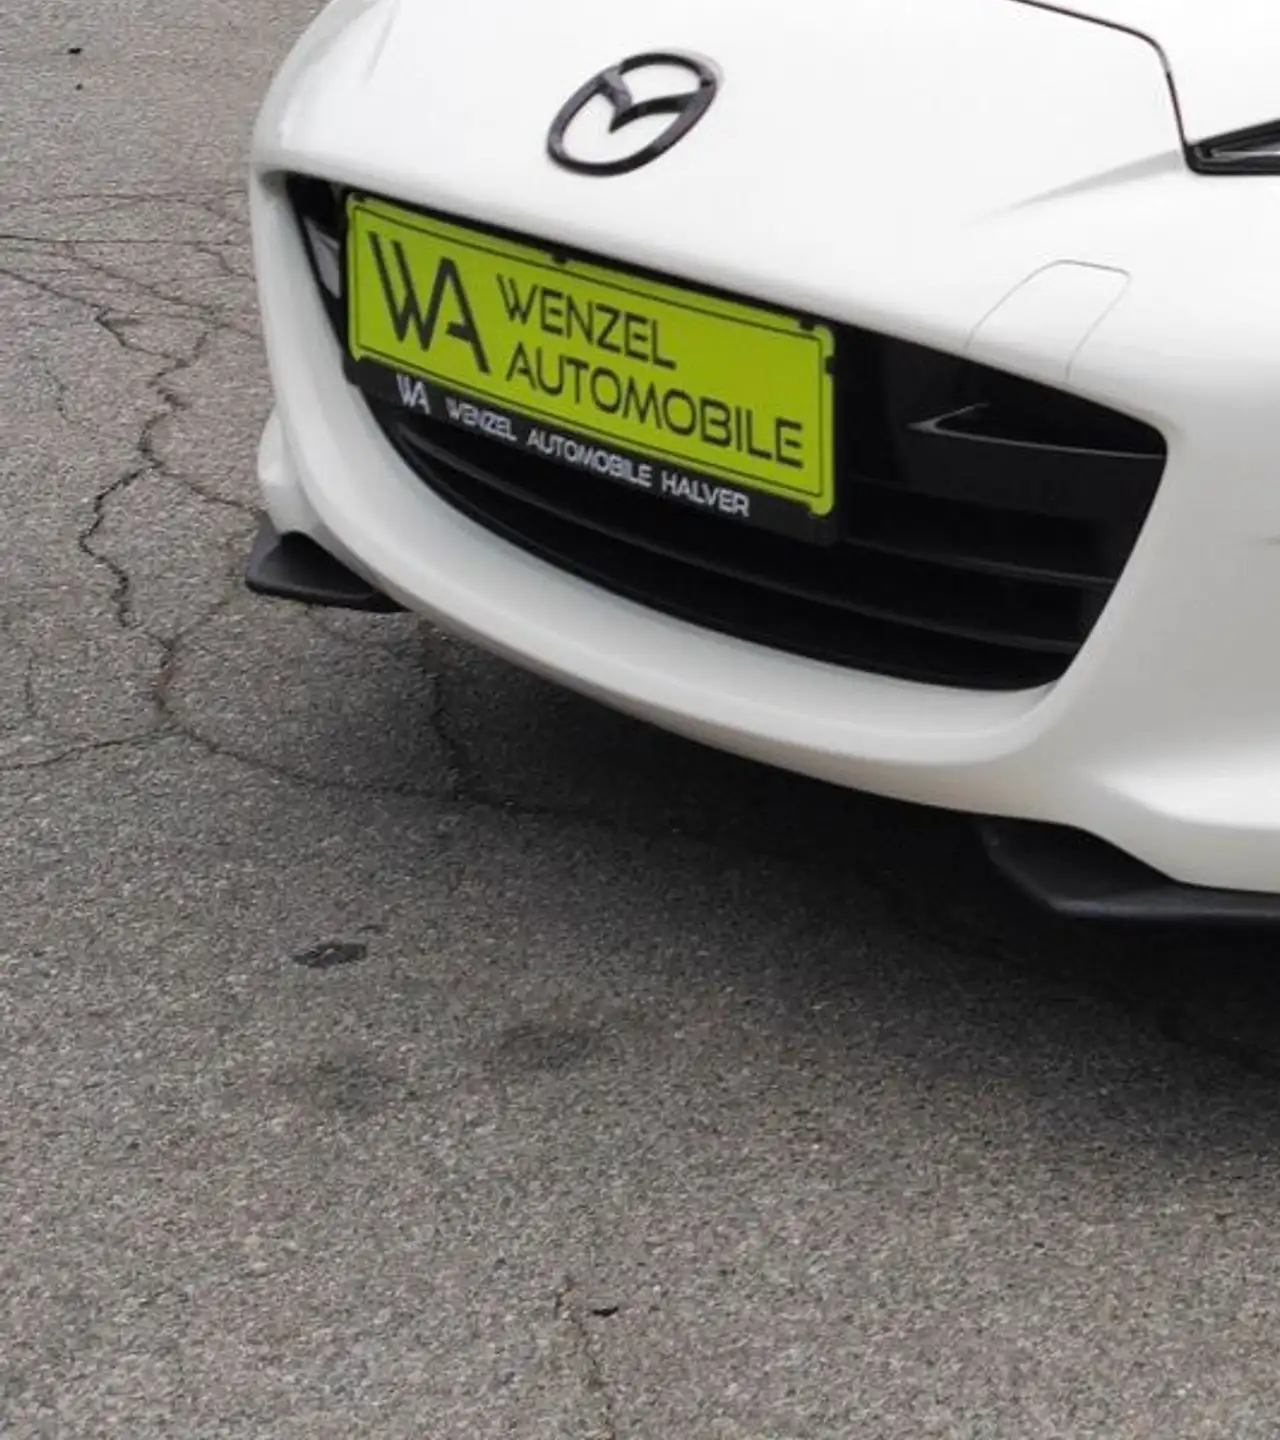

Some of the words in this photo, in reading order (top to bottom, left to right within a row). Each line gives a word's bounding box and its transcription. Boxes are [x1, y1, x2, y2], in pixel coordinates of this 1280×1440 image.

[496, 272, 678, 370] WENZEL
[445, 398, 518, 442] WENZEL
[527, 427, 653, 488] AUTOMOBILE
[661, 470, 751, 518] HALVER
[506, 343, 804, 469] AUTOMOBILE
